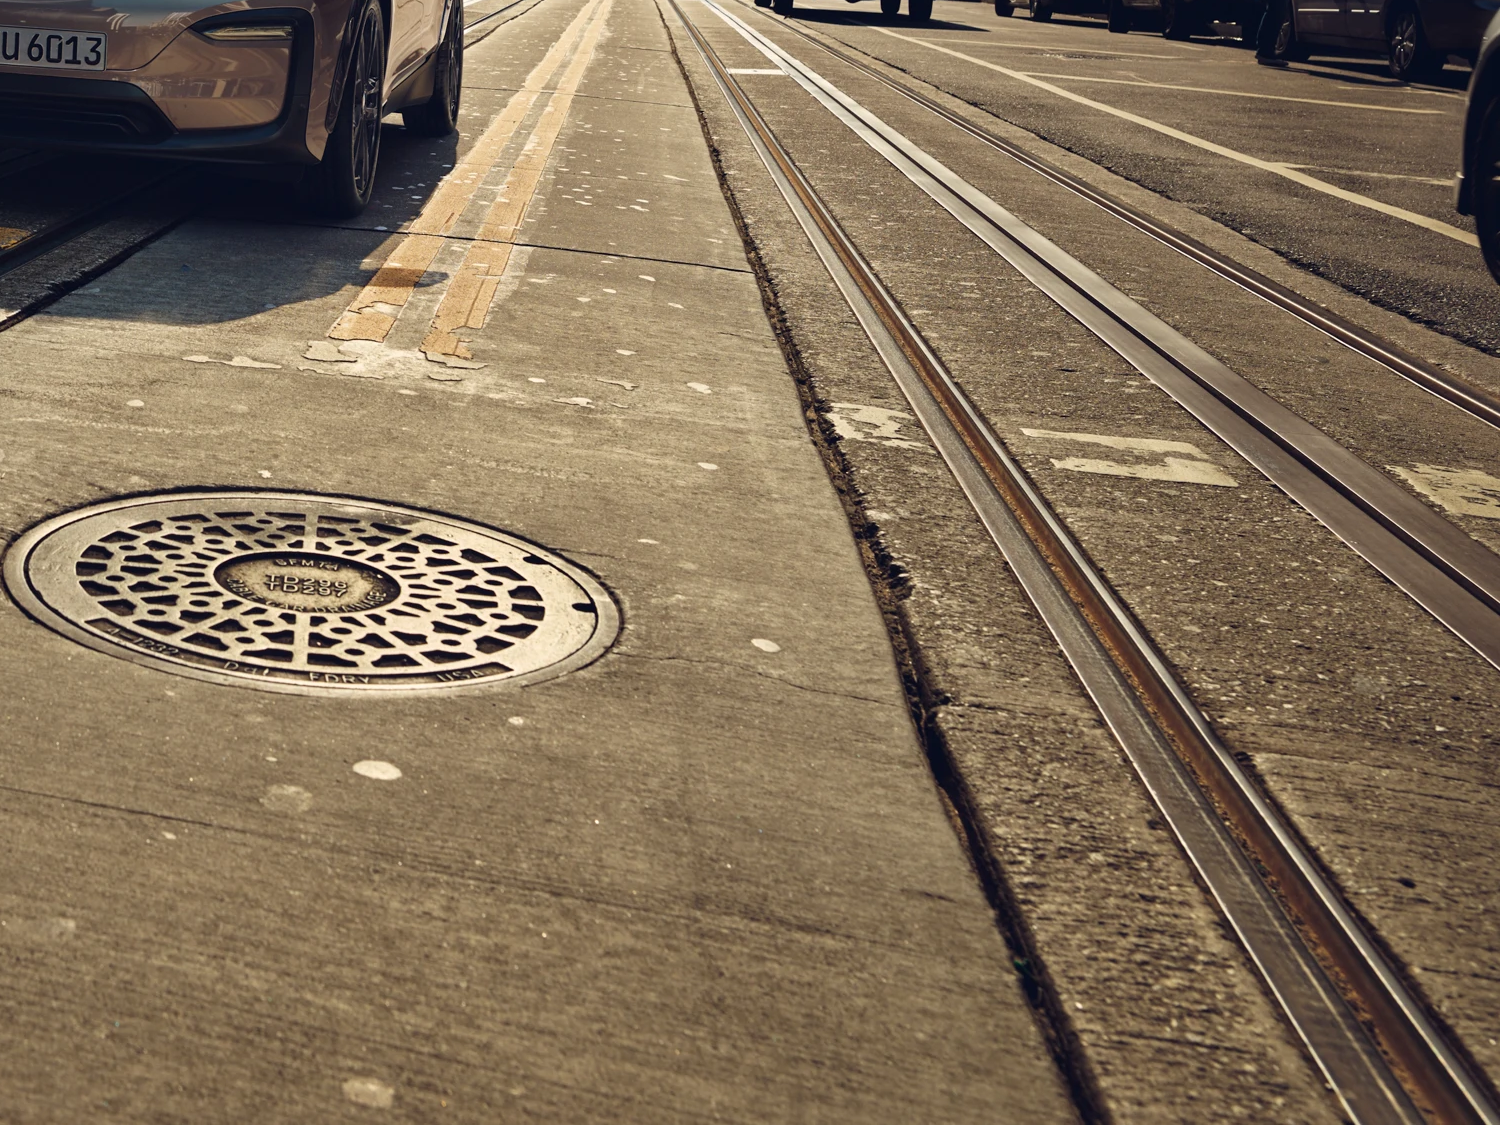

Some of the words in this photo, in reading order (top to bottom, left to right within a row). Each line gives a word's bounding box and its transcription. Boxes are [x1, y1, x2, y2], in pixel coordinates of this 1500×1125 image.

[27, 33, 102, 66] 6013
[265, 581, 348, 597] TD297
[266, 574, 348, 589] TD296
[226, 577, 263, 603] CABLE
[264, 600, 305, 613] CAR
